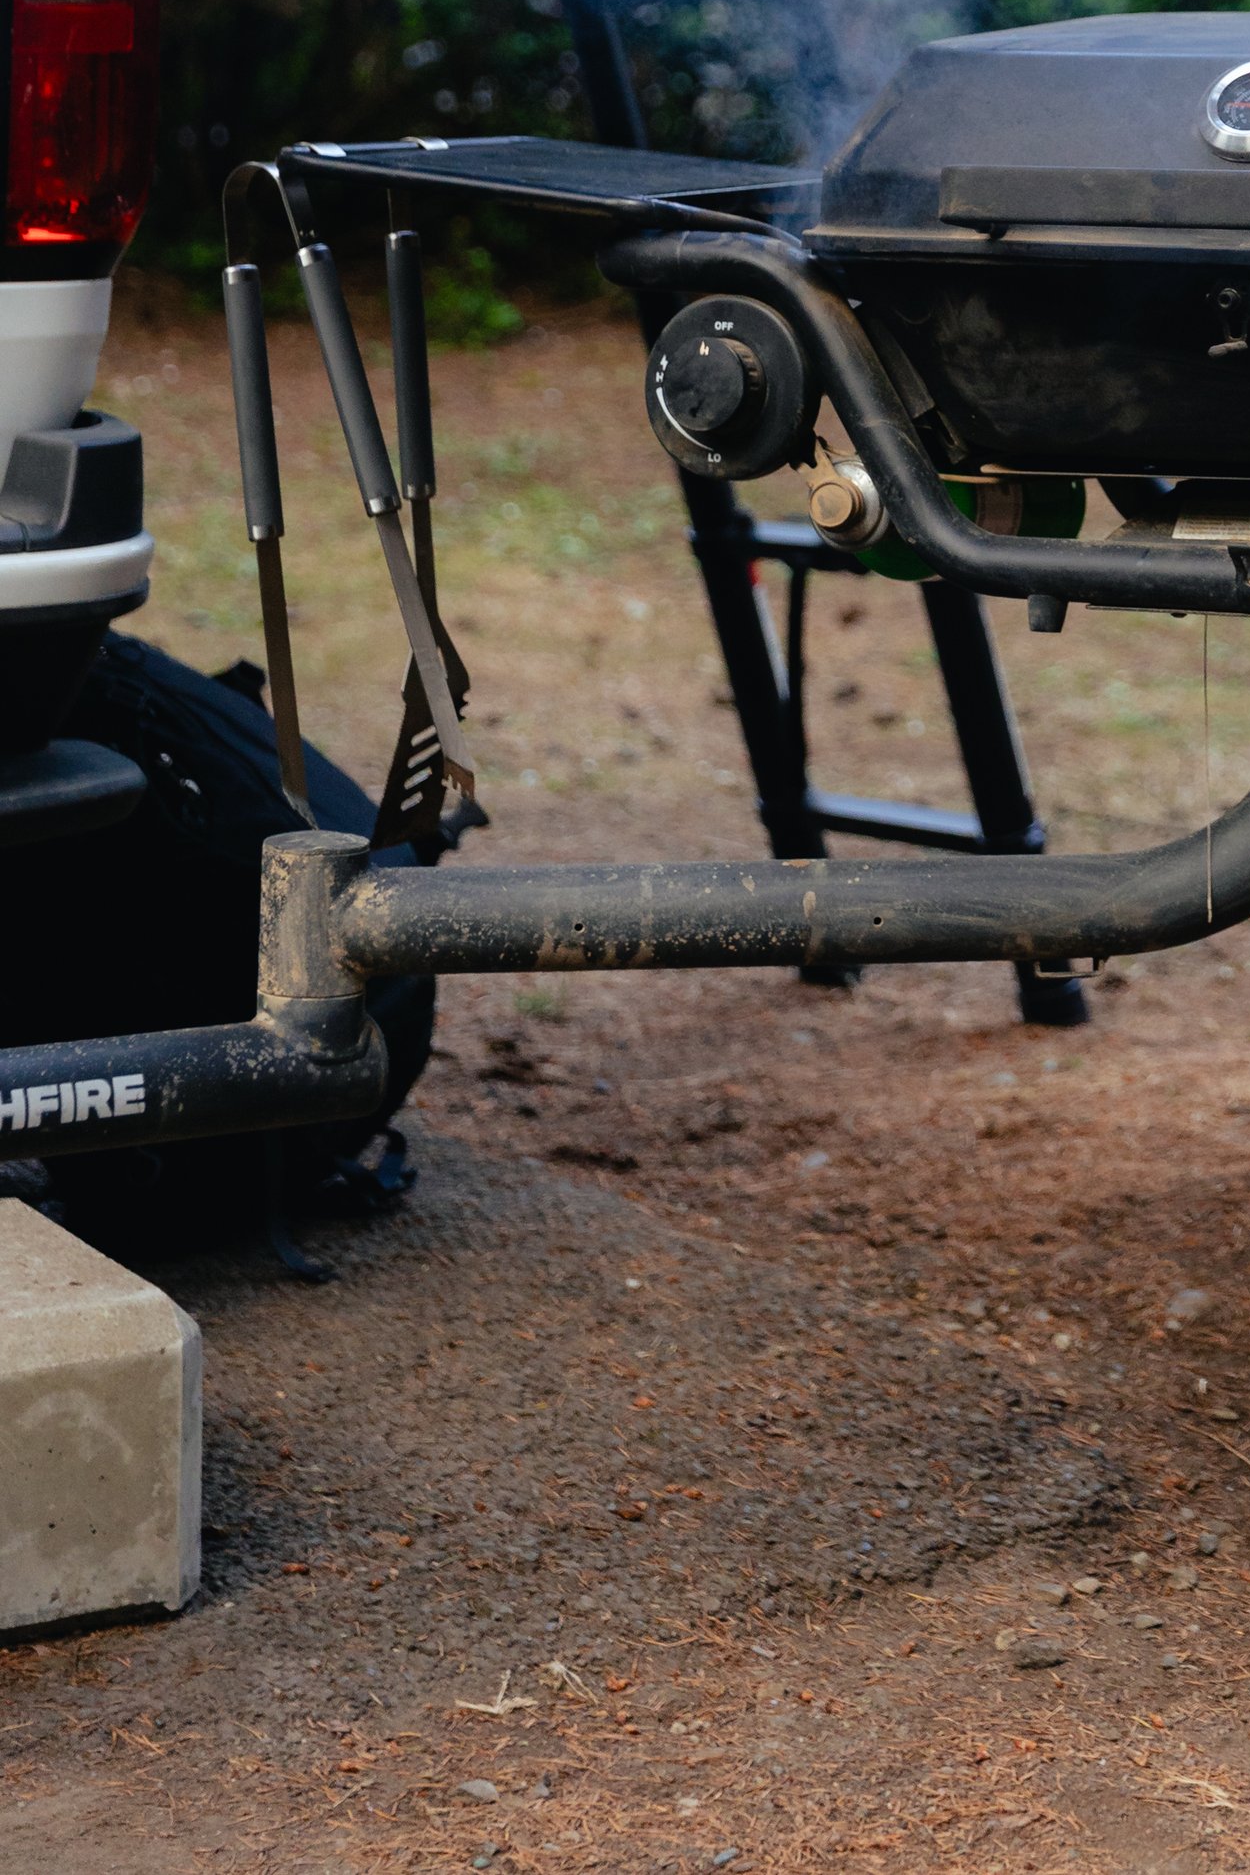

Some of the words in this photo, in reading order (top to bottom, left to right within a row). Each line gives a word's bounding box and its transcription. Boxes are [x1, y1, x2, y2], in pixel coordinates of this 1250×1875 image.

[714, 321, 734, 331] OFF
[708, 453, 721, 463] LO
[0, 1073, 146, 1131] HFIRE
